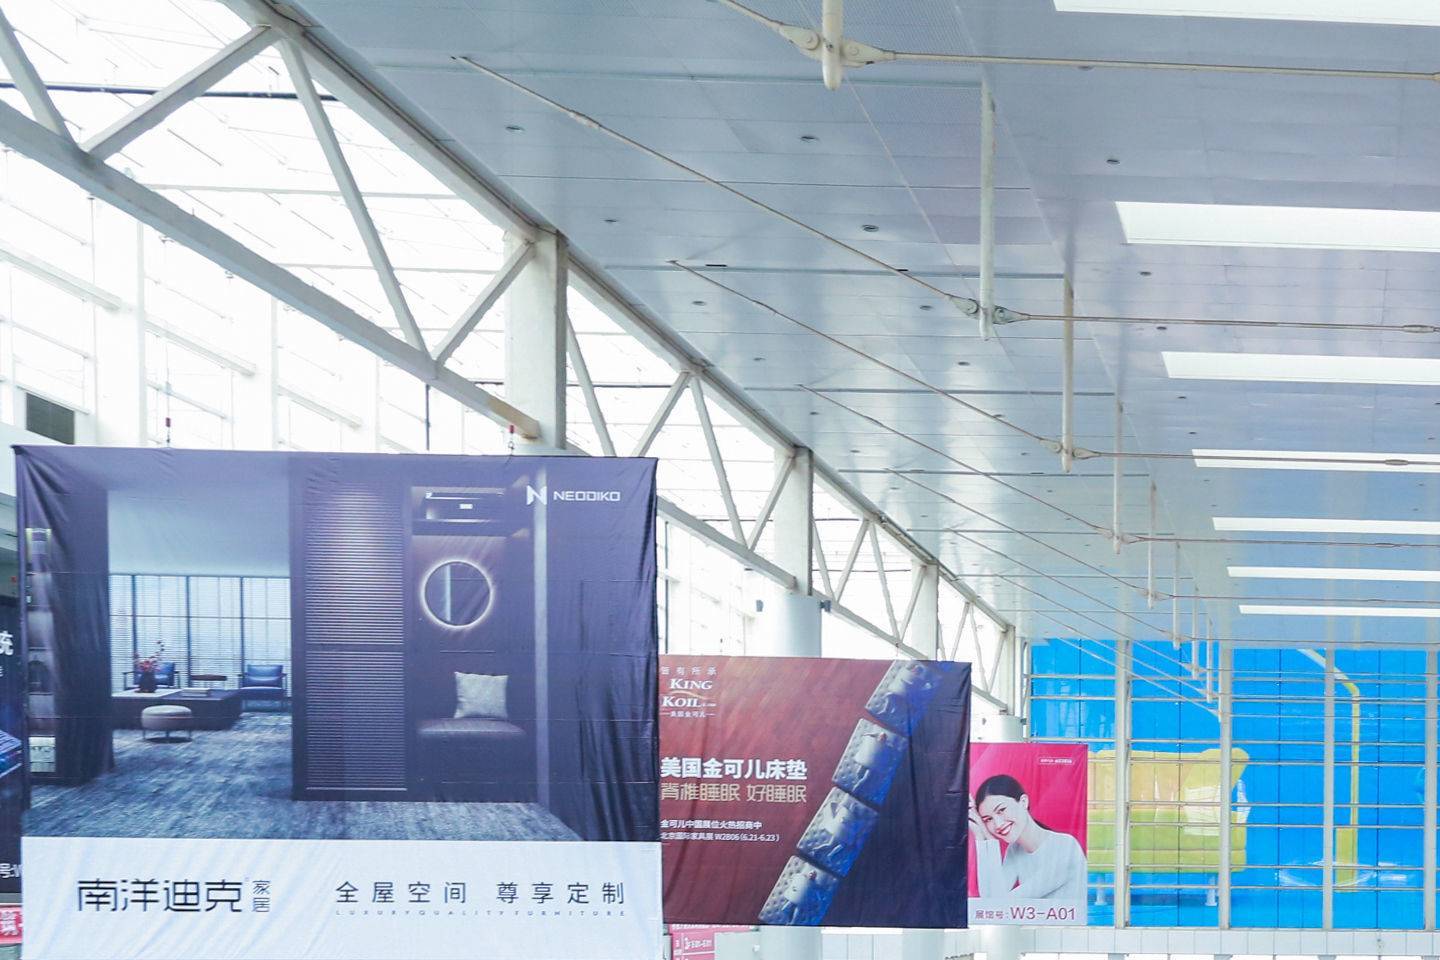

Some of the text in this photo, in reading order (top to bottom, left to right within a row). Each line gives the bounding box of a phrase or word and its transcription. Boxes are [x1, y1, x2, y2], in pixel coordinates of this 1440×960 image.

[553, 491, 621, 501] NEODIKO
[660, 757, 808, 780] 美国金可儿床垫
[747, 784, 807, 802] 好睡眠
[77, 878, 243, 912] 南洋迪克
[336, 881, 625, 904] 全屋空间 尊享定制
